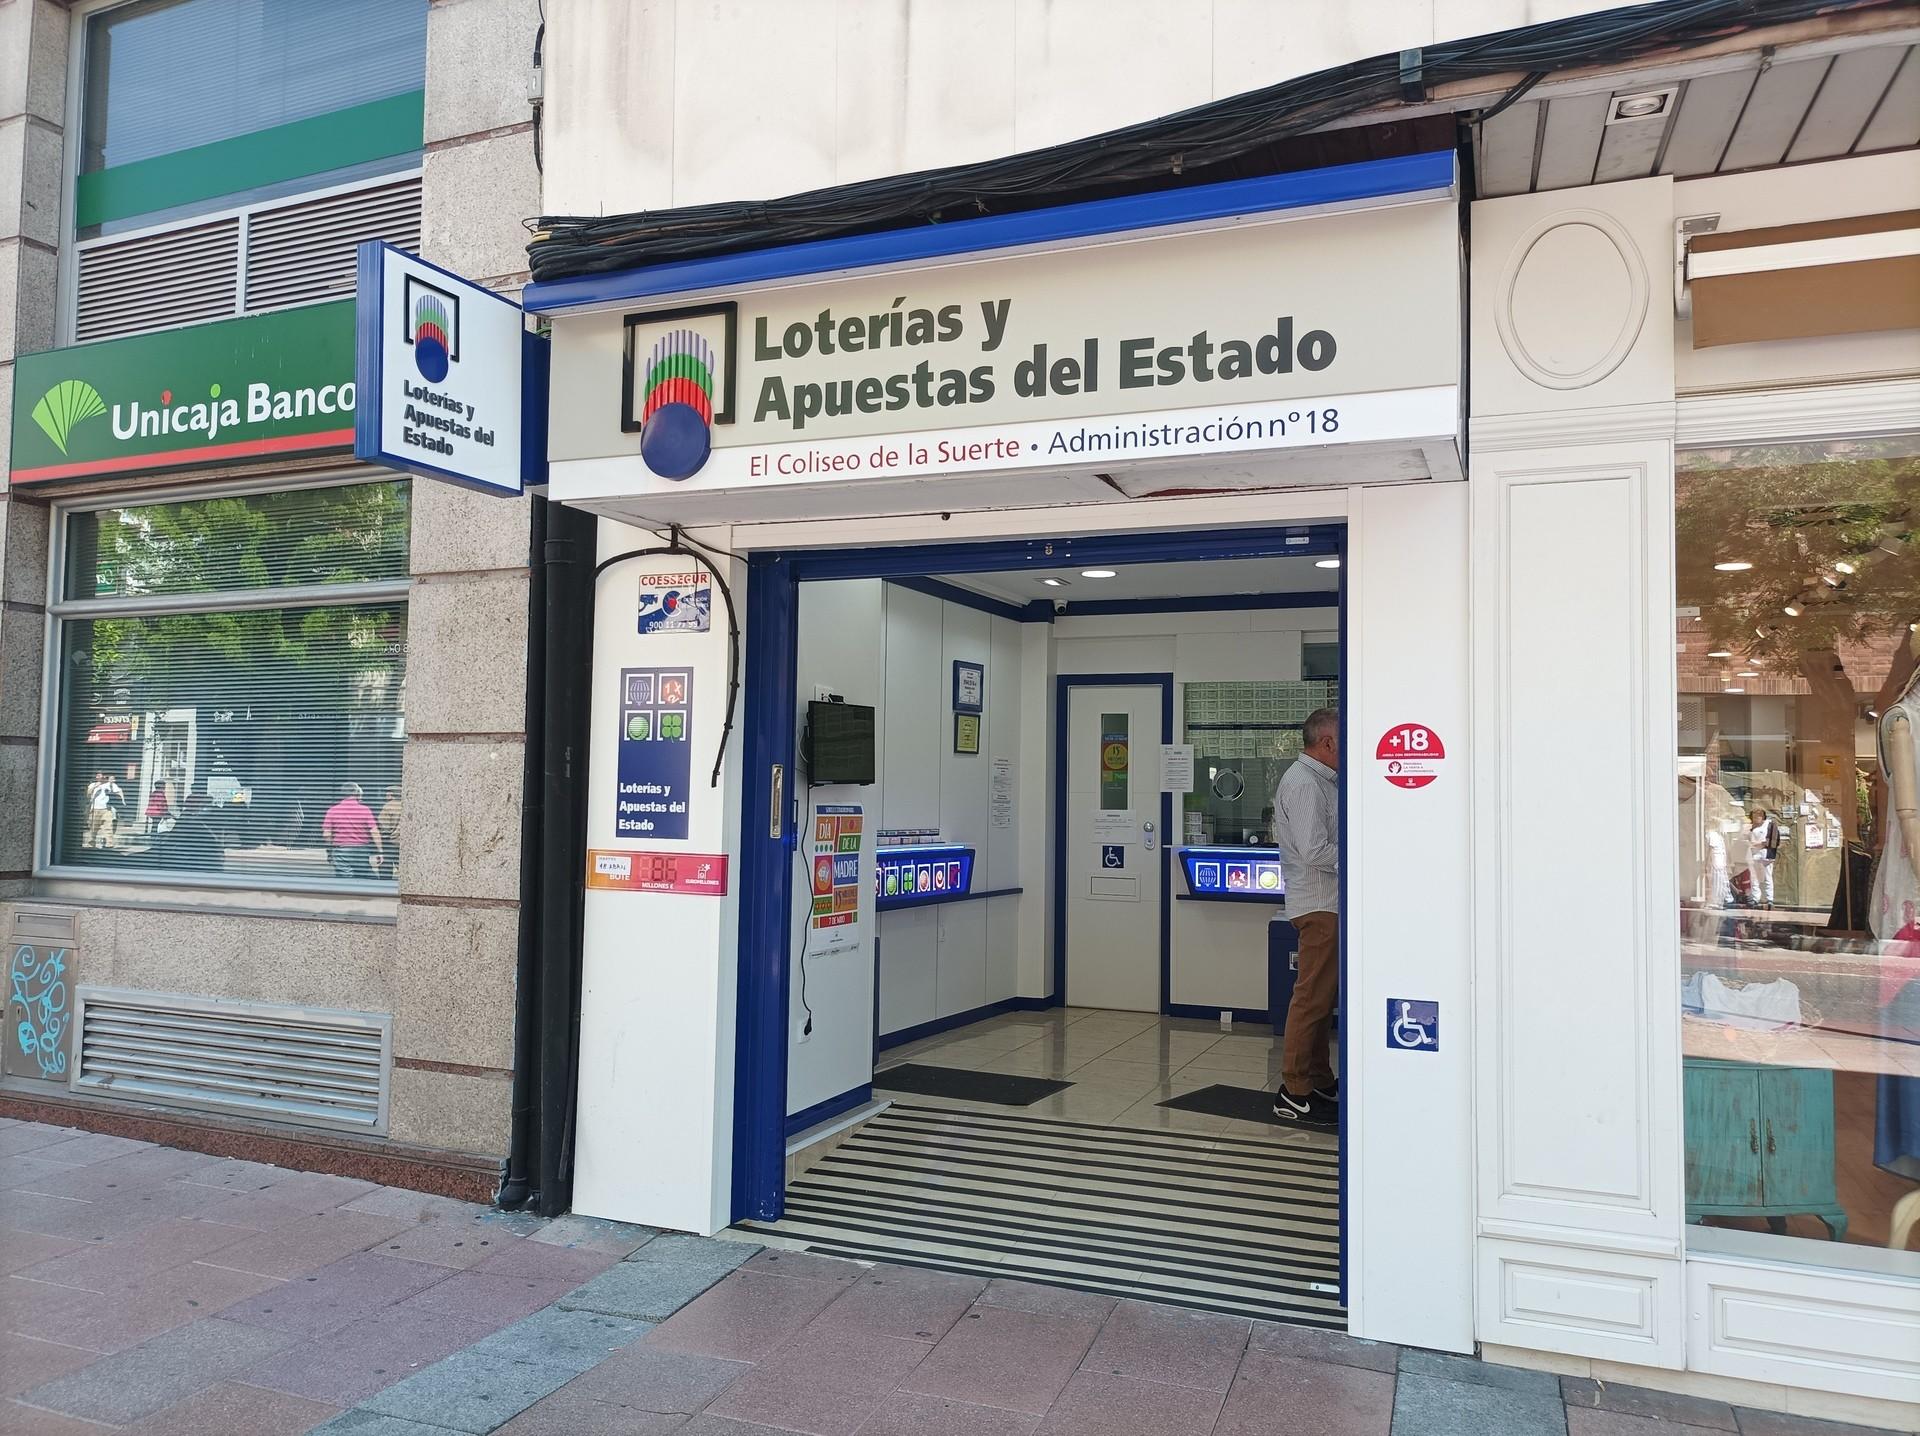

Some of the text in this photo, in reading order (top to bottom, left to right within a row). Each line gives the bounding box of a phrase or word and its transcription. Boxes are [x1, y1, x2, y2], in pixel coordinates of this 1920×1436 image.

[755, 296, 1012, 361] Loterías y
[753, 316, 1337, 430] Apuestas del Estado
[112, 382, 356, 440] Unicaja Banco
[403, 379, 475, 422] Loterías y
[403, 403, 494, 447] Apuestas del
[402, 426, 454, 456] Estado
[750, 454, 768, 477] El
[777, 451, 861, 474] Coliseo
[869, 445, 899, 468] de
[908, 443, 928, 466] la
[938, 440, 1020, 463] Suerte
[1048, 416, 1263, 454] Administración
[641, 574, 708, 586] COESSEGUR
[1389, 729, 1429, 751] +18
[620, 782, 671, 797] Loterías y
[619, 801, 686, 814] Apuestas del
[618, 818, 655, 831] Estado
[834, 860, 858, 878] MADRE
